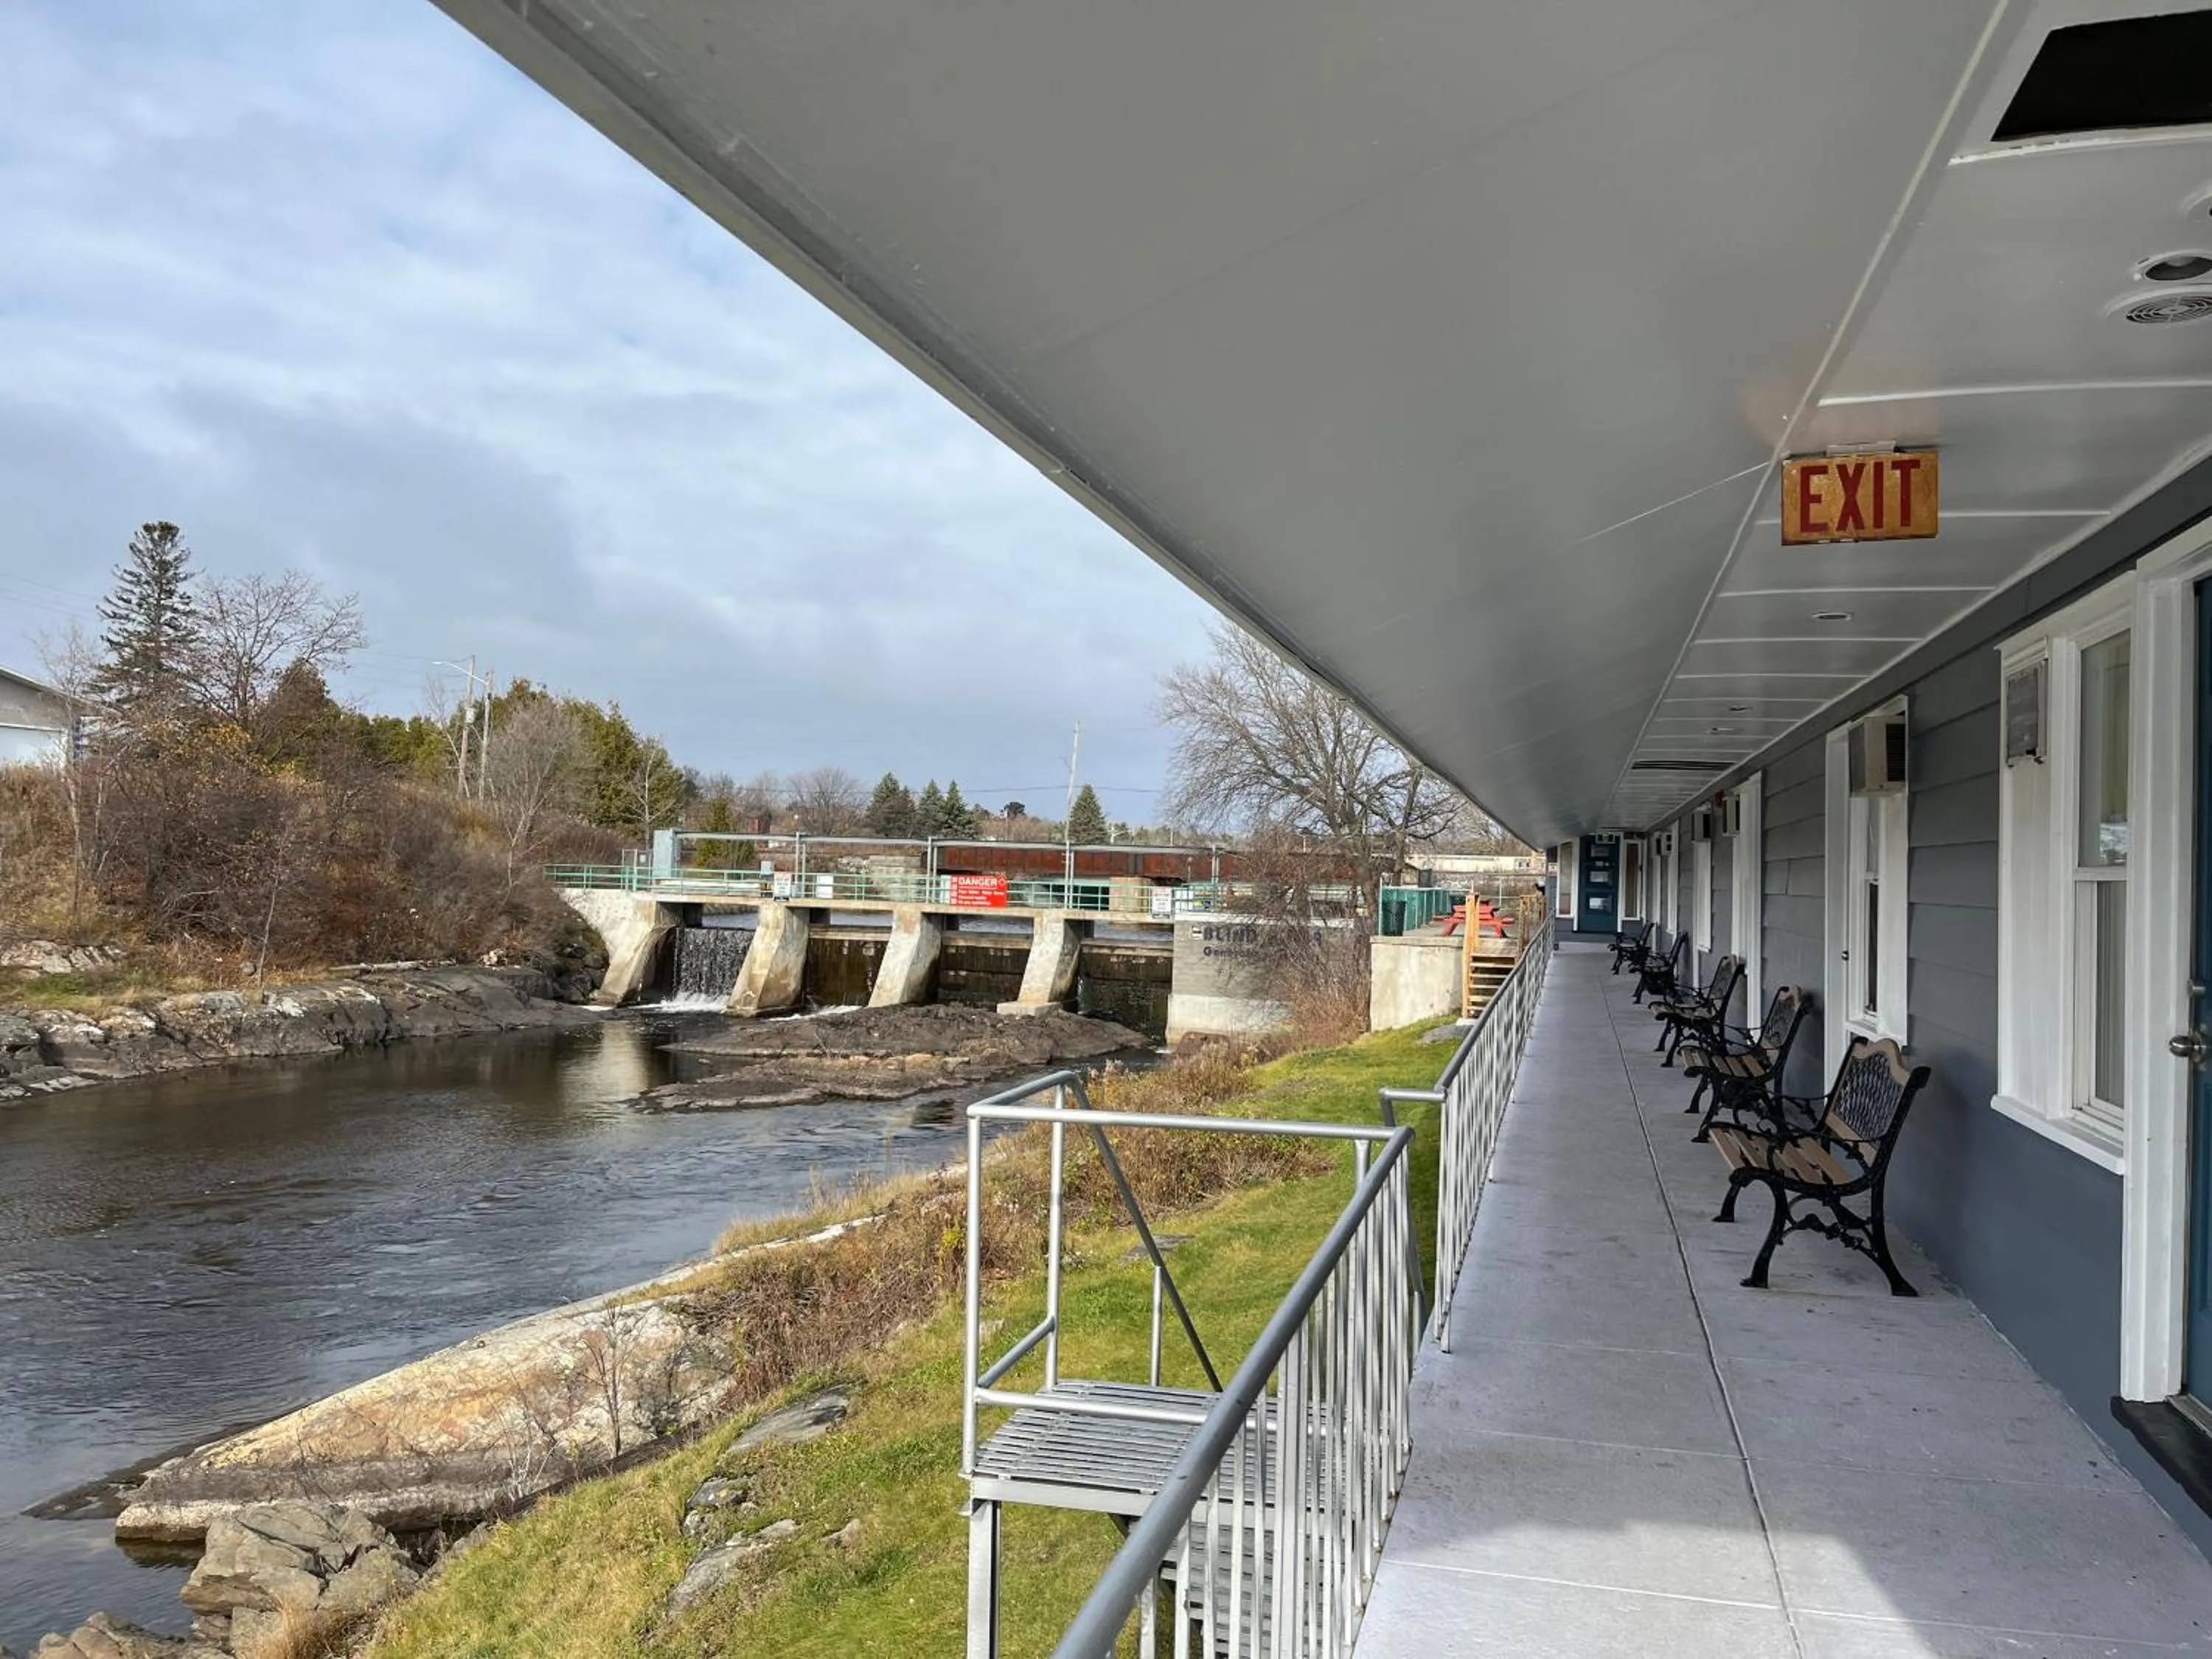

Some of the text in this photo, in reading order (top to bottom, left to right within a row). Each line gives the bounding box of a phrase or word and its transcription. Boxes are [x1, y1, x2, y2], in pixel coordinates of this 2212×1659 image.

[1800, 459, 1921, 533] EXIT
[958, 877, 998, 886] DANGER
[1203, 926, 1257, 944] BLIND
